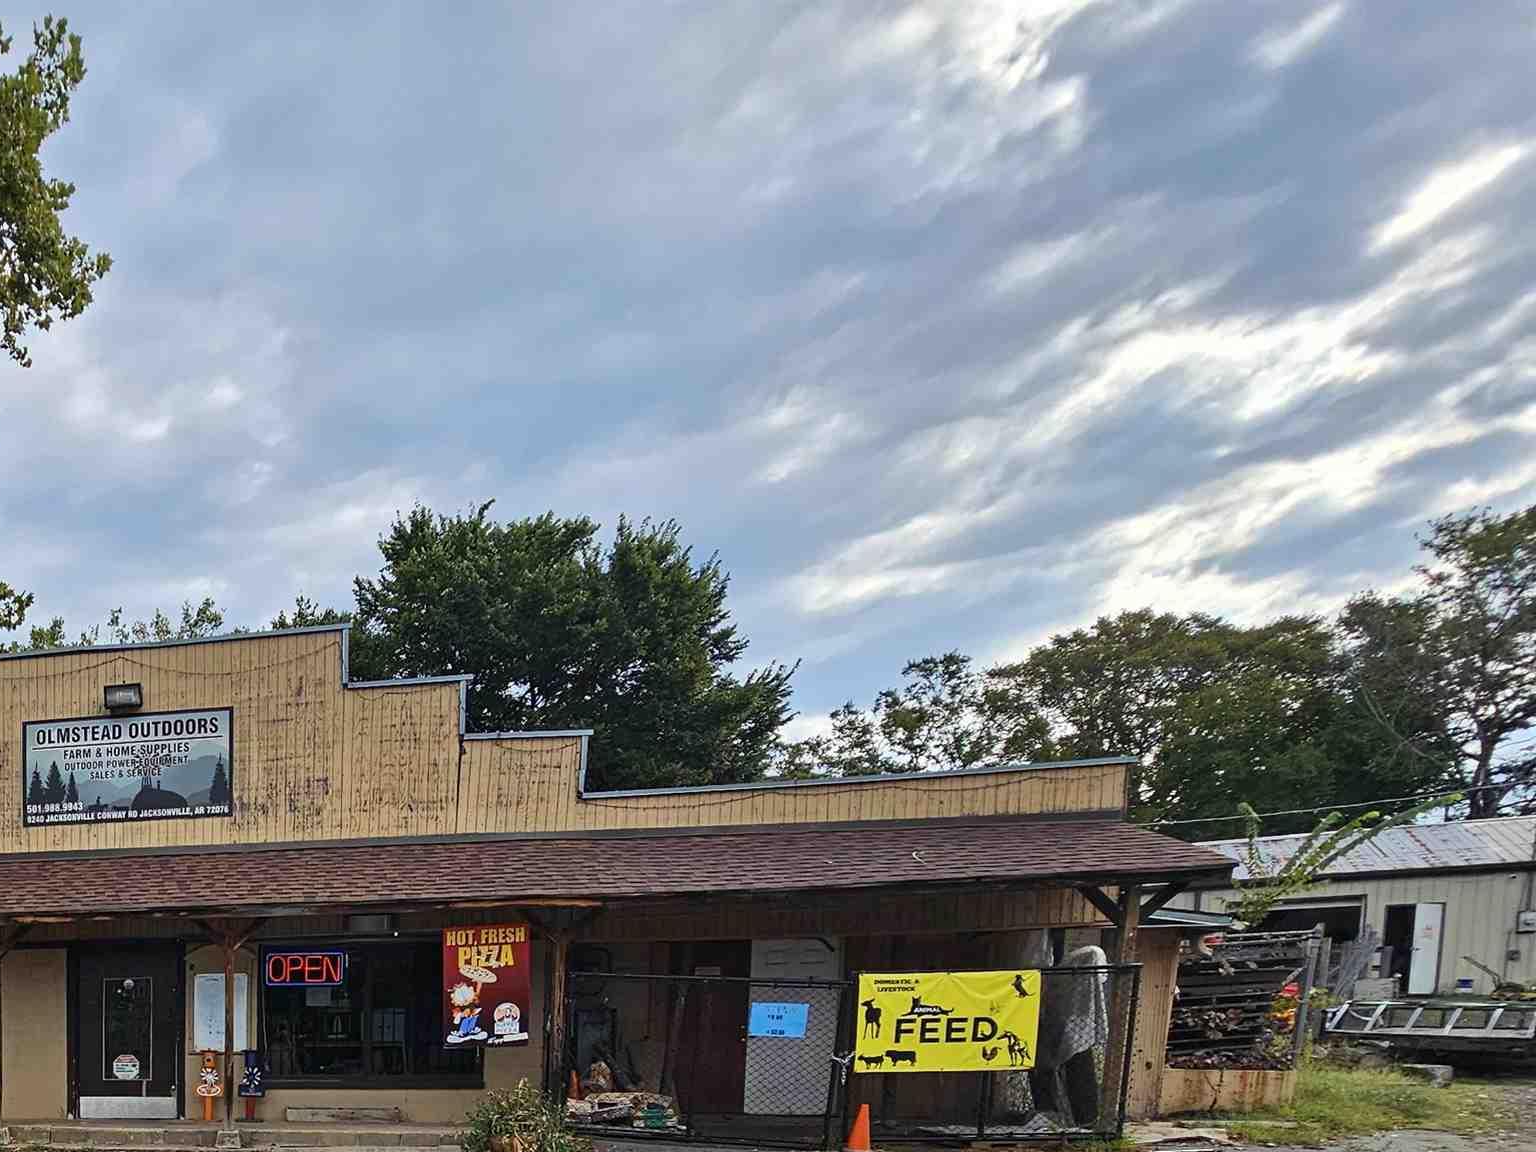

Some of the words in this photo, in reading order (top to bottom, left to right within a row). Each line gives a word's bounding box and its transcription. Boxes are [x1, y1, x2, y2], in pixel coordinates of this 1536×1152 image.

[37, 724, 122, 745] OLMSTEAD
[129, 717, 219, 738] OUTDOORS
[64, 748, 91, 760] FARM
[96, 747, 102, 757] &
[106, 745, 136, 757] HOME
[140, 742, 190, 755] SUPPLIES
[64, 760, 104, 771] OUTDOOR
[106, 758, 136, 768] POWER
[138, 755, 189, 768] EQUIPMENT
[90, 769, 114, 780] SALES
[126, 766, 163, 778] SERVICE
[45, 812, 95, 823] JACKSONVILLE
[97, 810, 127, 819] CONWAY
[194, 805, 205, 814] AR
[480, 927, 525, 945] FRESH
[458, 944, 515, 969] PIZZA
[269, 955, 340, 982] OPEN
[894, 1016, 998, 1043] FEED
